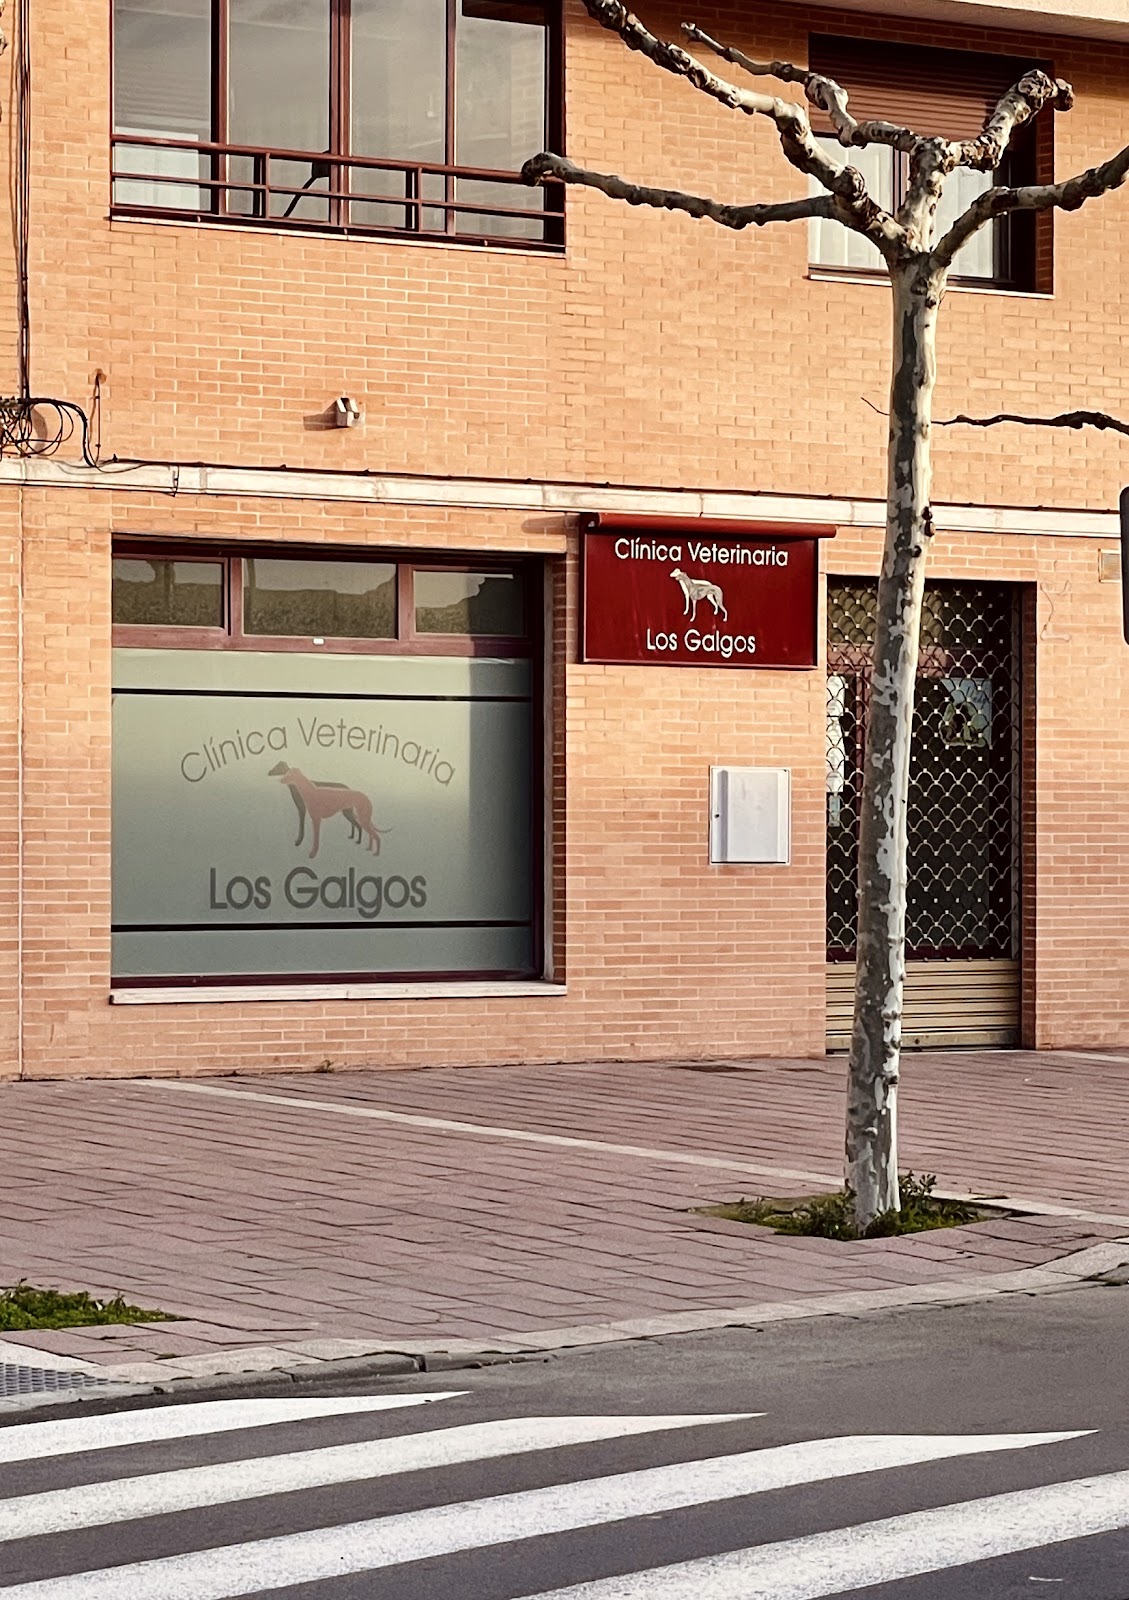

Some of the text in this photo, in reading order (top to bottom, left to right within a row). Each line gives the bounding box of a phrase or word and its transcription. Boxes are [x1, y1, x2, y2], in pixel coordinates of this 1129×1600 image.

[614, 537, 789, 566] Clínica Veterinaria
[646, 628, 756, 658] Los Galgos
[181, 716, 456, 787] Clínica Veterinaria
[209, 866, 427, 919] Los Galgos
